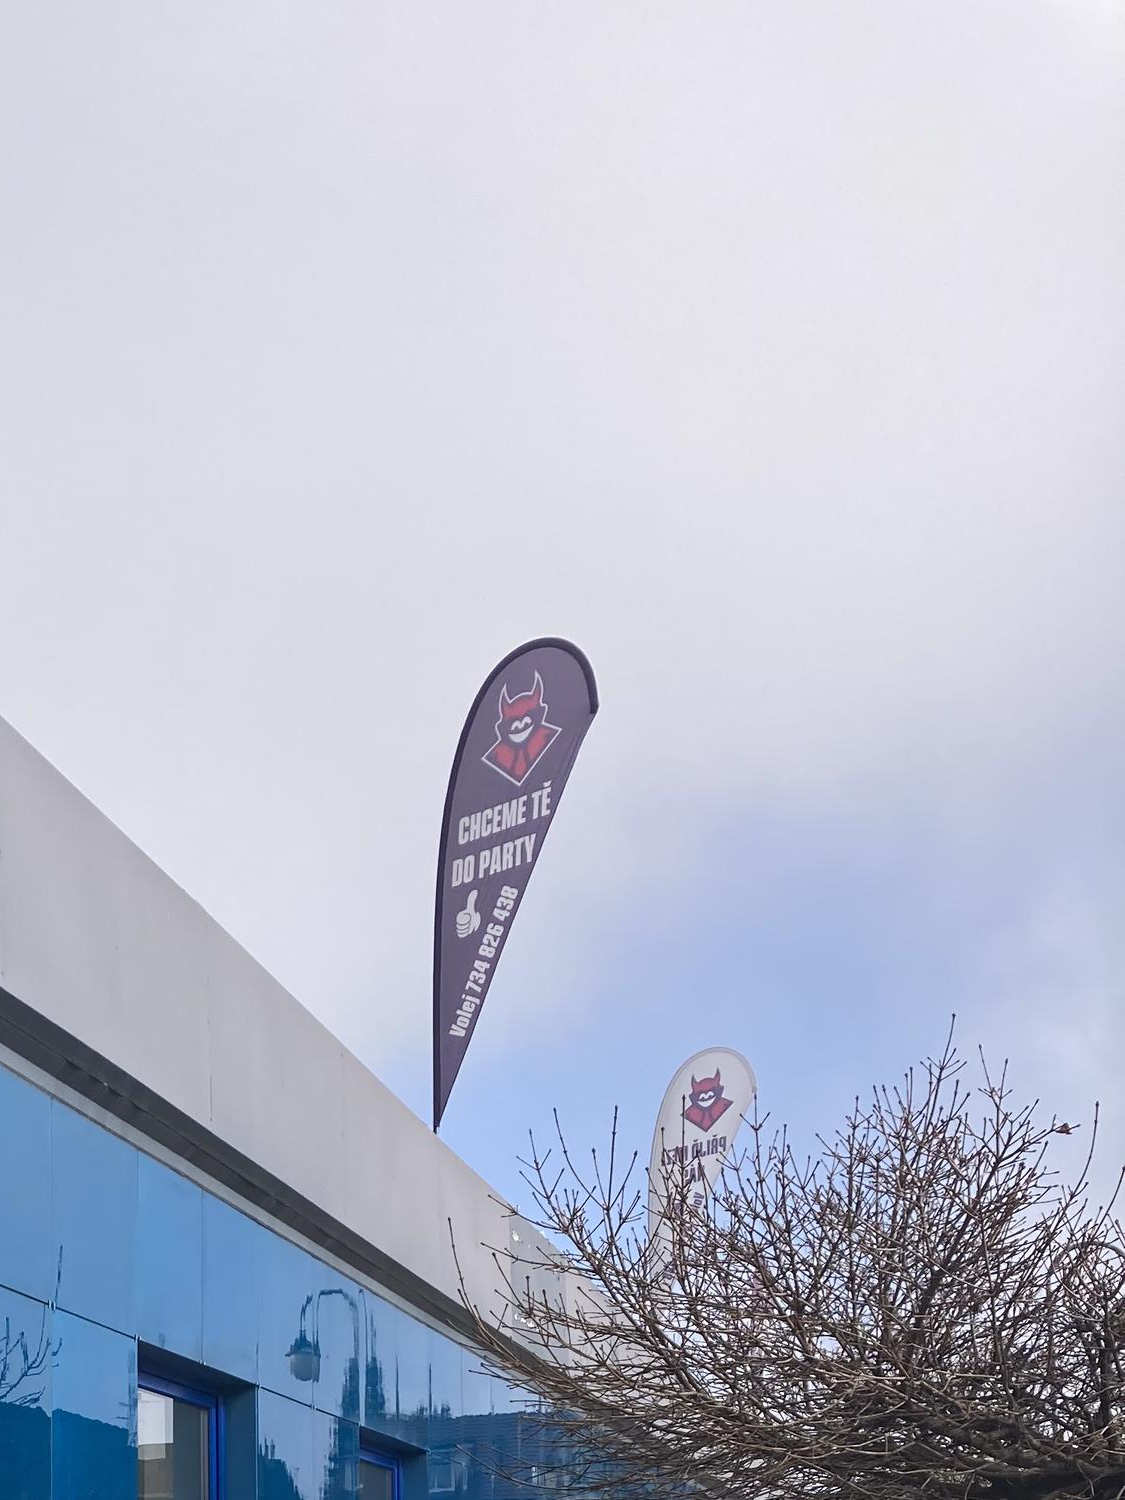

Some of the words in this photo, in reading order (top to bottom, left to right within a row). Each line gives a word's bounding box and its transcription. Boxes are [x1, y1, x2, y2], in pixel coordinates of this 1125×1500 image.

[458, 795, 528, 845] CHCEME
[531, 780, 552, 820] TĚ
[451, 854, 475, 888] DO
[478, 833, 537, 879] PARTY
[449, 993, 481, 1038] Volej
[465, 959, 491, 993] 734
[478, 922, 504, 959] 826
[493, 885, 519, 922] 438
